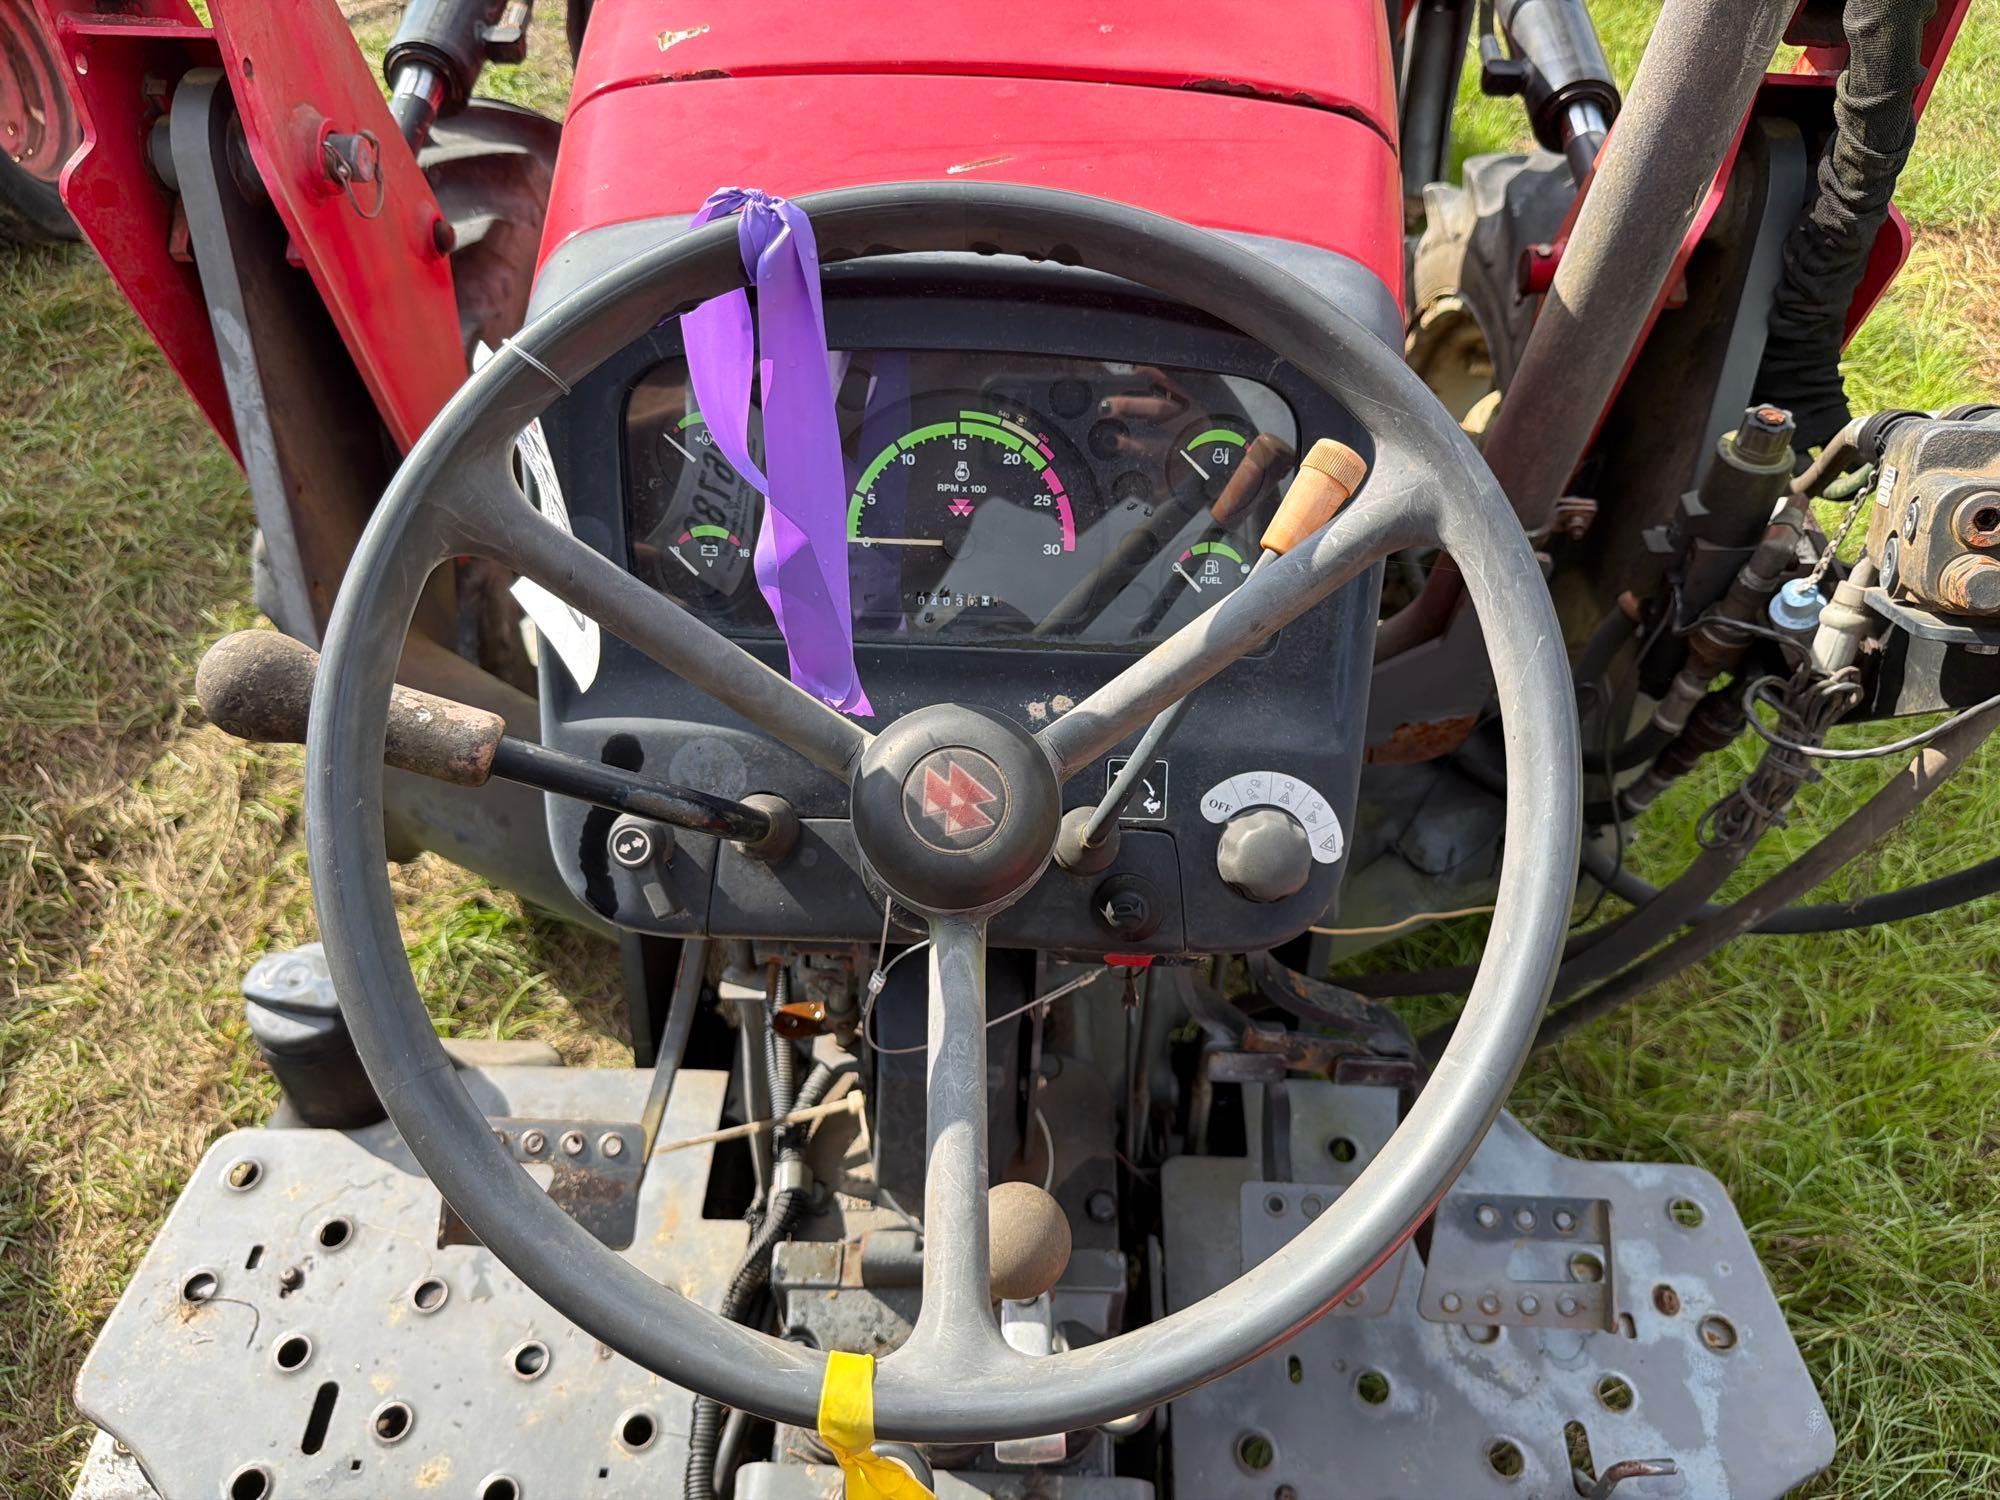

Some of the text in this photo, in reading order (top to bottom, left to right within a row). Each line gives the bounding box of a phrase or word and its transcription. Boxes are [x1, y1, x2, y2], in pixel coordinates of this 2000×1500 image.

[952, 439, 967, 450] 15
[900, 454, 916, 465] 10
[1003, 454, 1021, 465] 20
[937, 484, 959, 493] RPM
[970, 485, 987, 494] 100
[867, 494, 876, 506] 5
[1034, 495, 1052, 506] 25
[738, 549, 751, 558] 16
[1043, 544, 1061, 555] 30
[706, 560, 714, 568] V
[1200, 576, 1222, 585] FUEL
[1209, 799, 1233, 813] OFF
